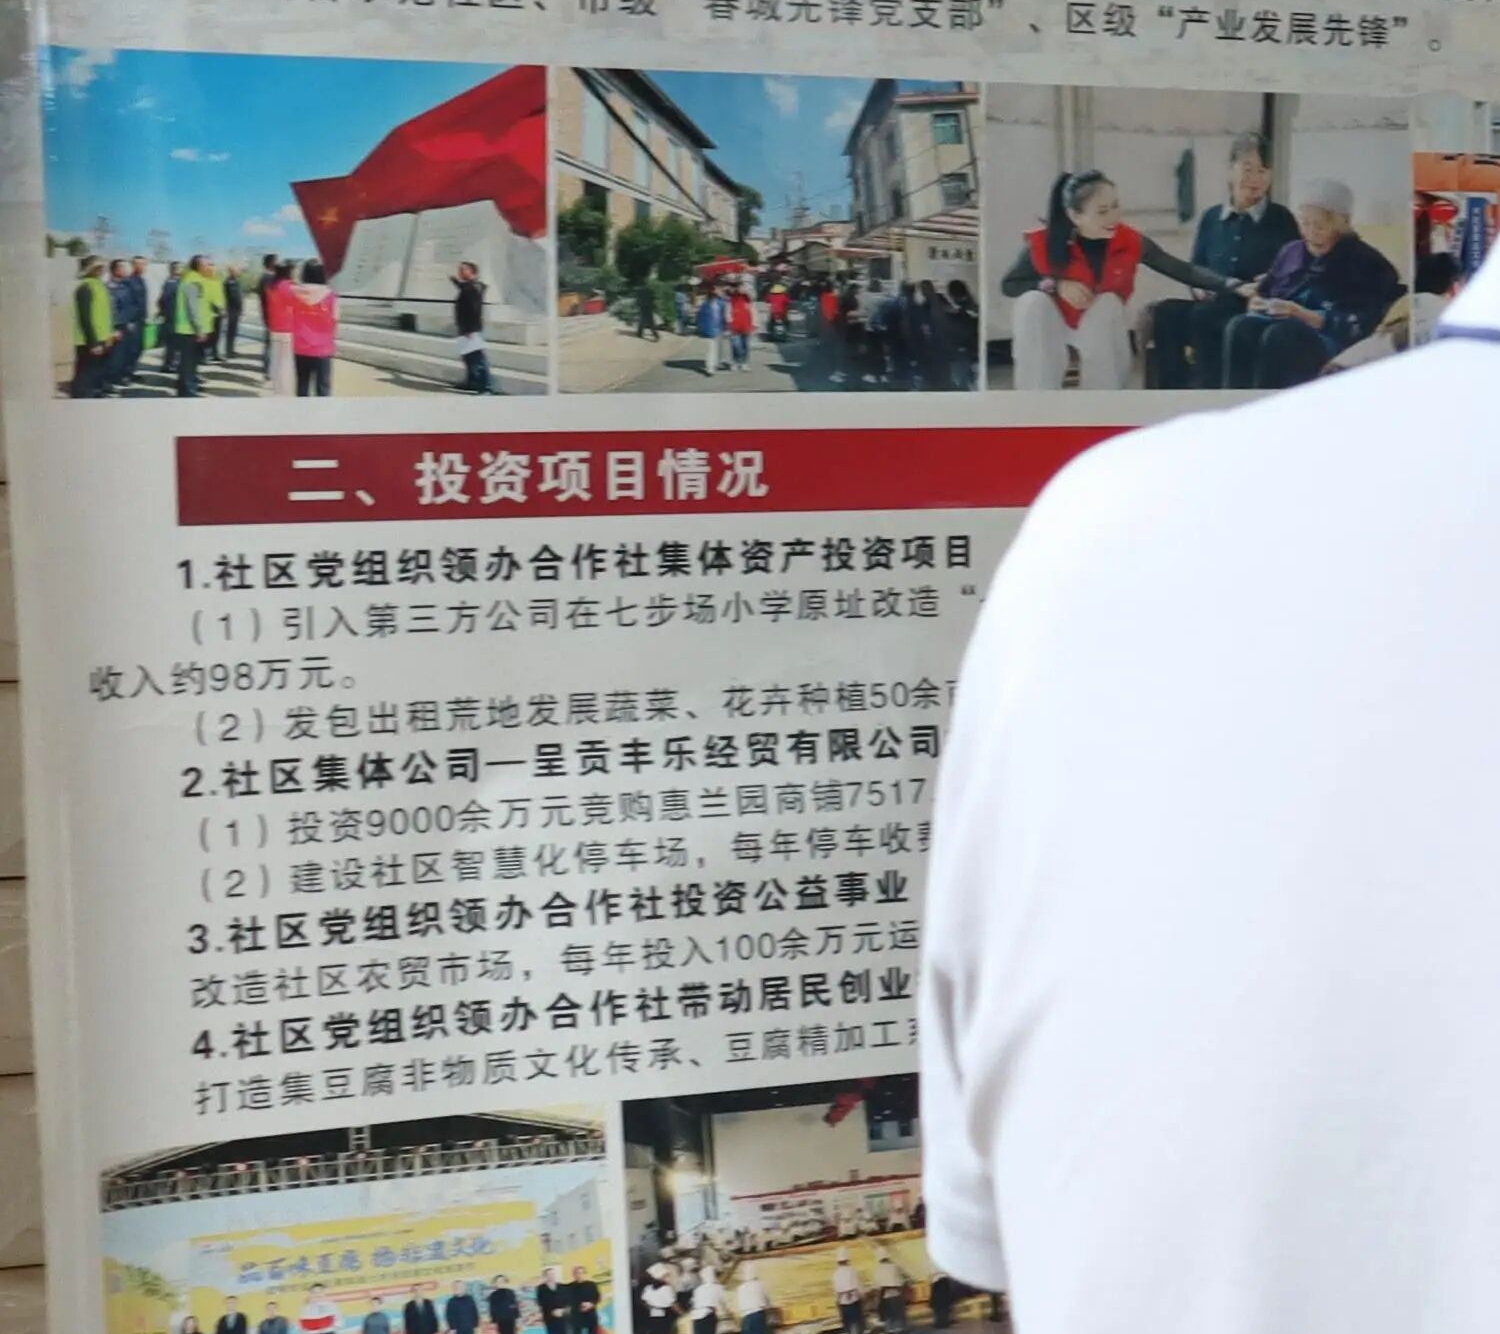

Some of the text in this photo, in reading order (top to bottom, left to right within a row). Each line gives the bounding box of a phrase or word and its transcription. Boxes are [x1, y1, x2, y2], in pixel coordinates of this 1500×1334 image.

[288, 451, 769, 504] 二、投资项目情况
[89, 658, 359, 702] 收入约98万元。
